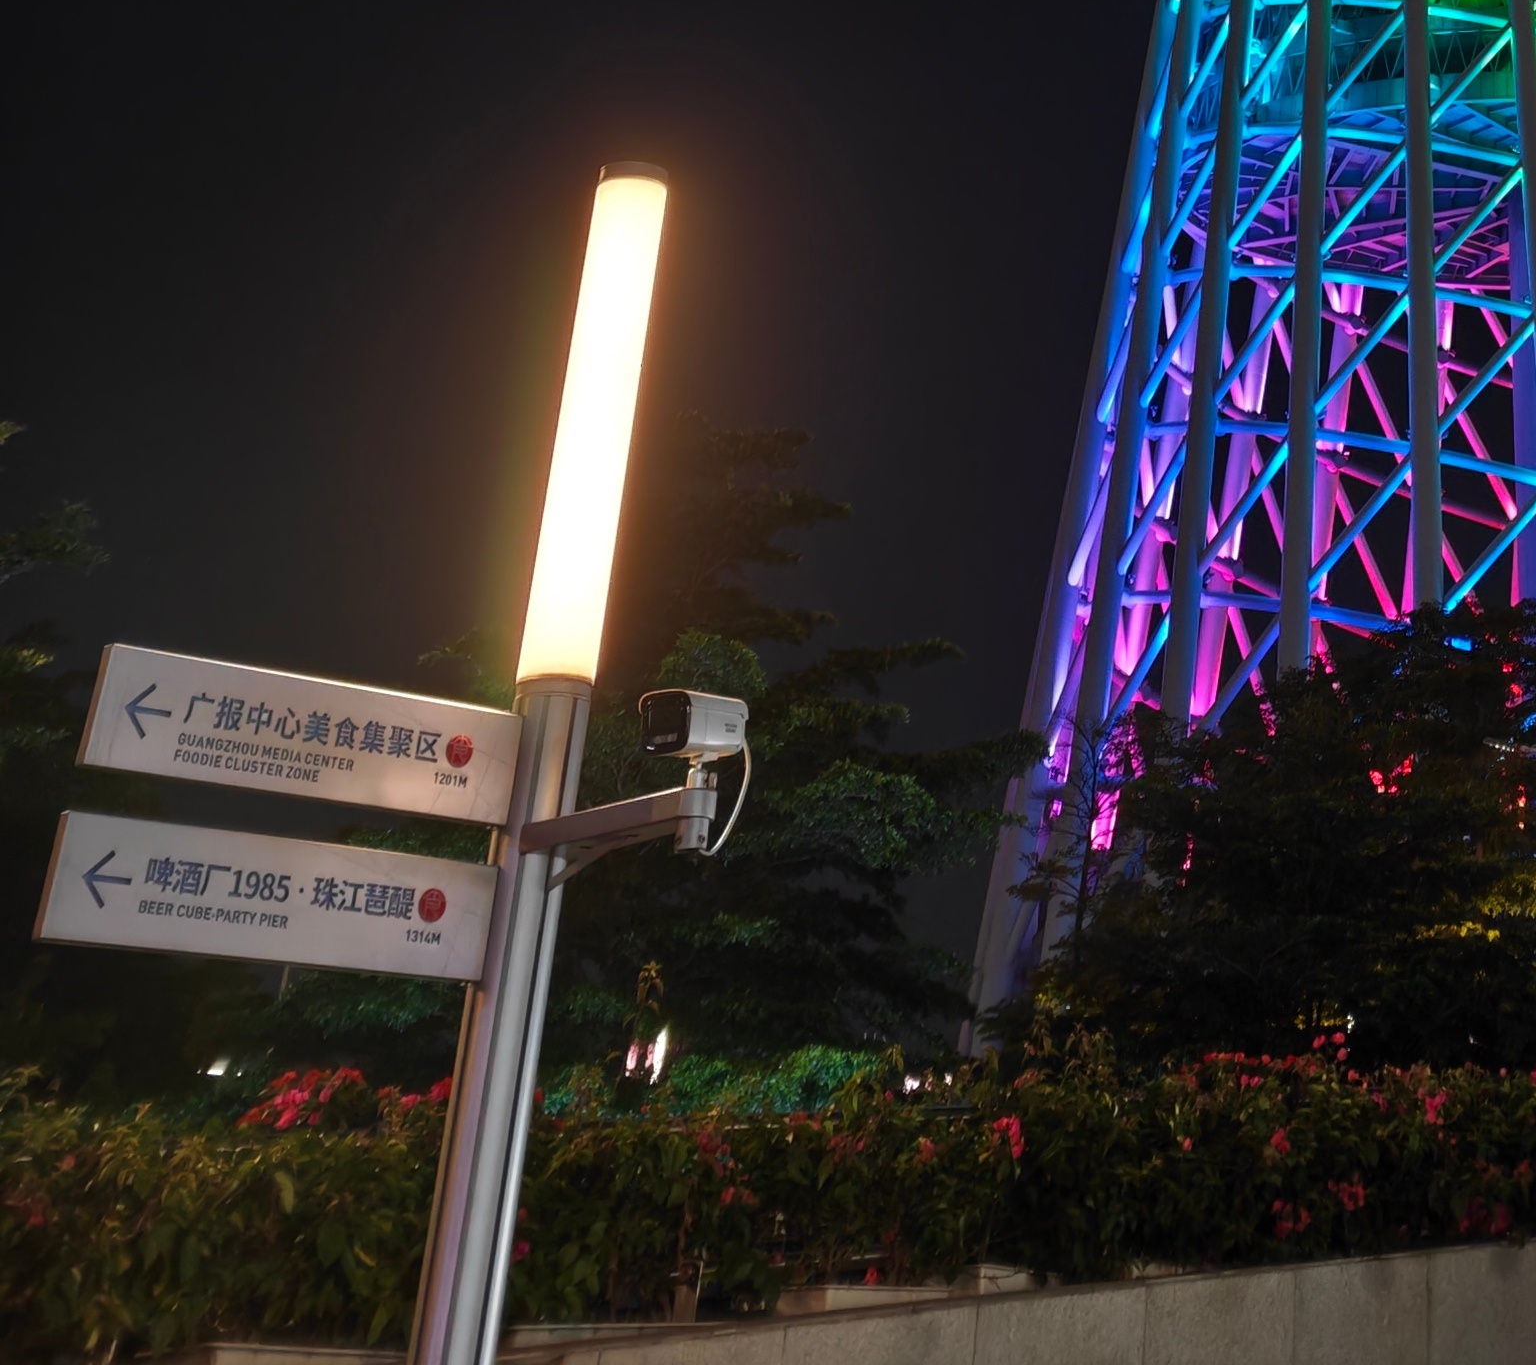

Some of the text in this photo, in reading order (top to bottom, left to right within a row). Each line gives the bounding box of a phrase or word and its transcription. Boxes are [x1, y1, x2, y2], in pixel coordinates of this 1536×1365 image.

[183, 692, 442, 763] 广报中心美食集聚区
[174, 749, 320, 782] FOODIE CLUSTER ZONE
[178, 732, 354, 771] GUANGZHOU MEDIA CENTER
[434, 772, 467, 788] 1201M
[138, 900, 174, 916] BEER
[259, 912, 289, 929] PIER
[406, 929, 441, 945] 1314M
